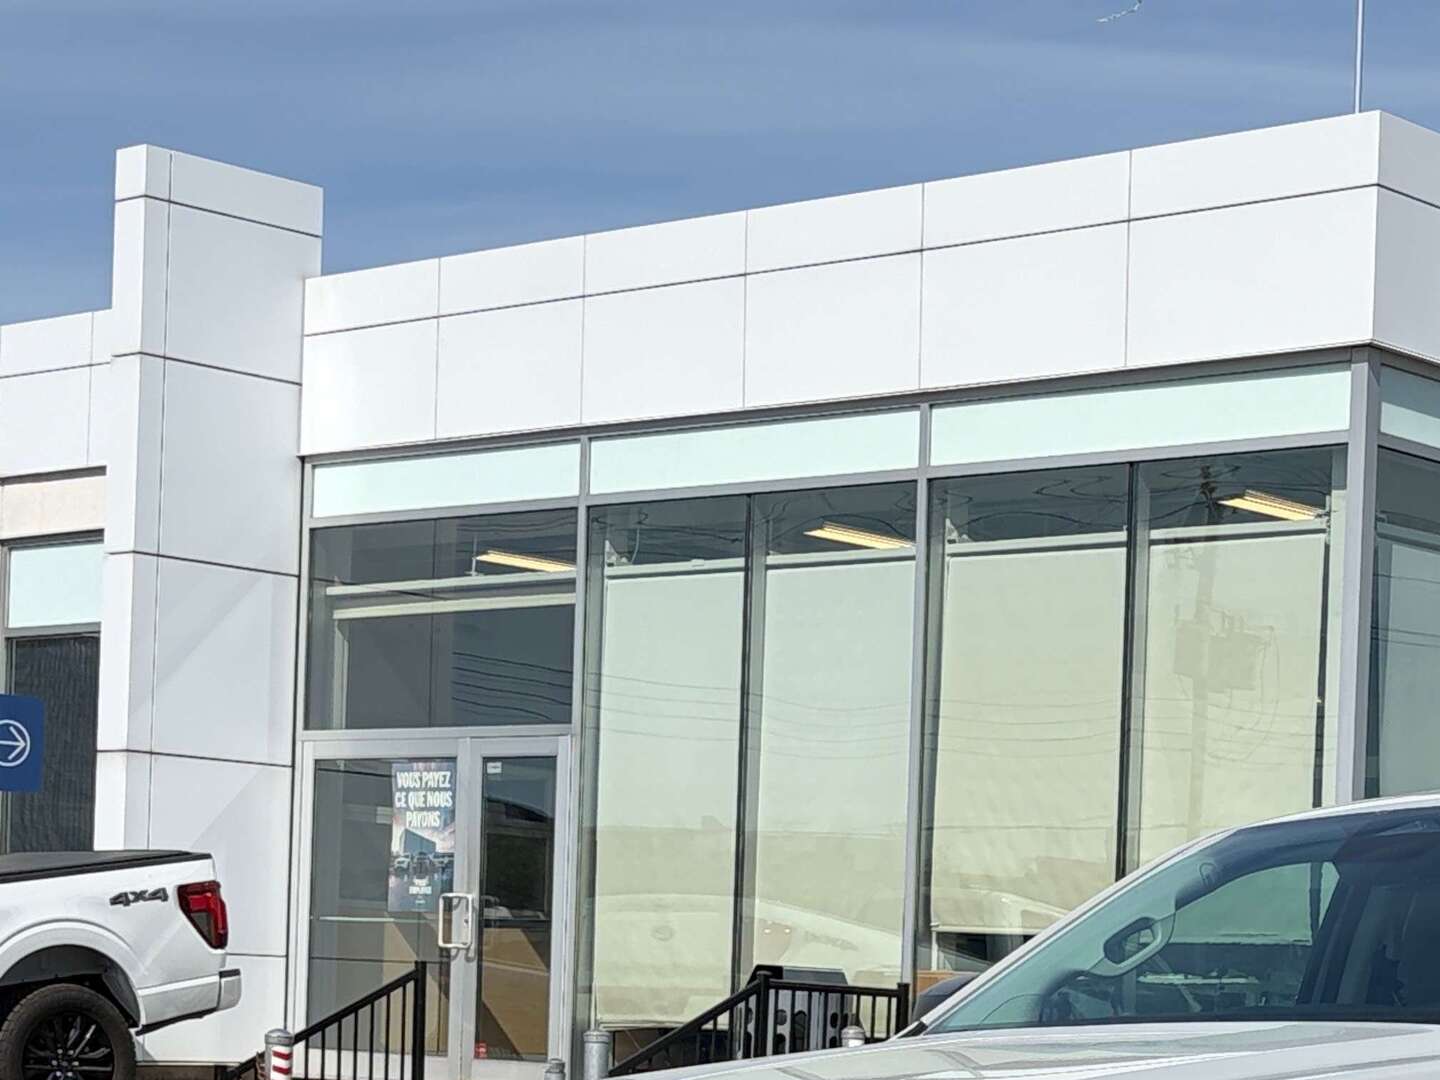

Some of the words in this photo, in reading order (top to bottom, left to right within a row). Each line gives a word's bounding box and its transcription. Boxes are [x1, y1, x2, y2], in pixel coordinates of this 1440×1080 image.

[396, 771, 421, 788] VOUS
[421, 771, 451, 787] PAYEZ
[395, 792, 407, 808] CE
[408, 791, 426, 810] QUE
[427, 791, 453, 808] NOUS
[406, 811, 440, 828] PAYONS
